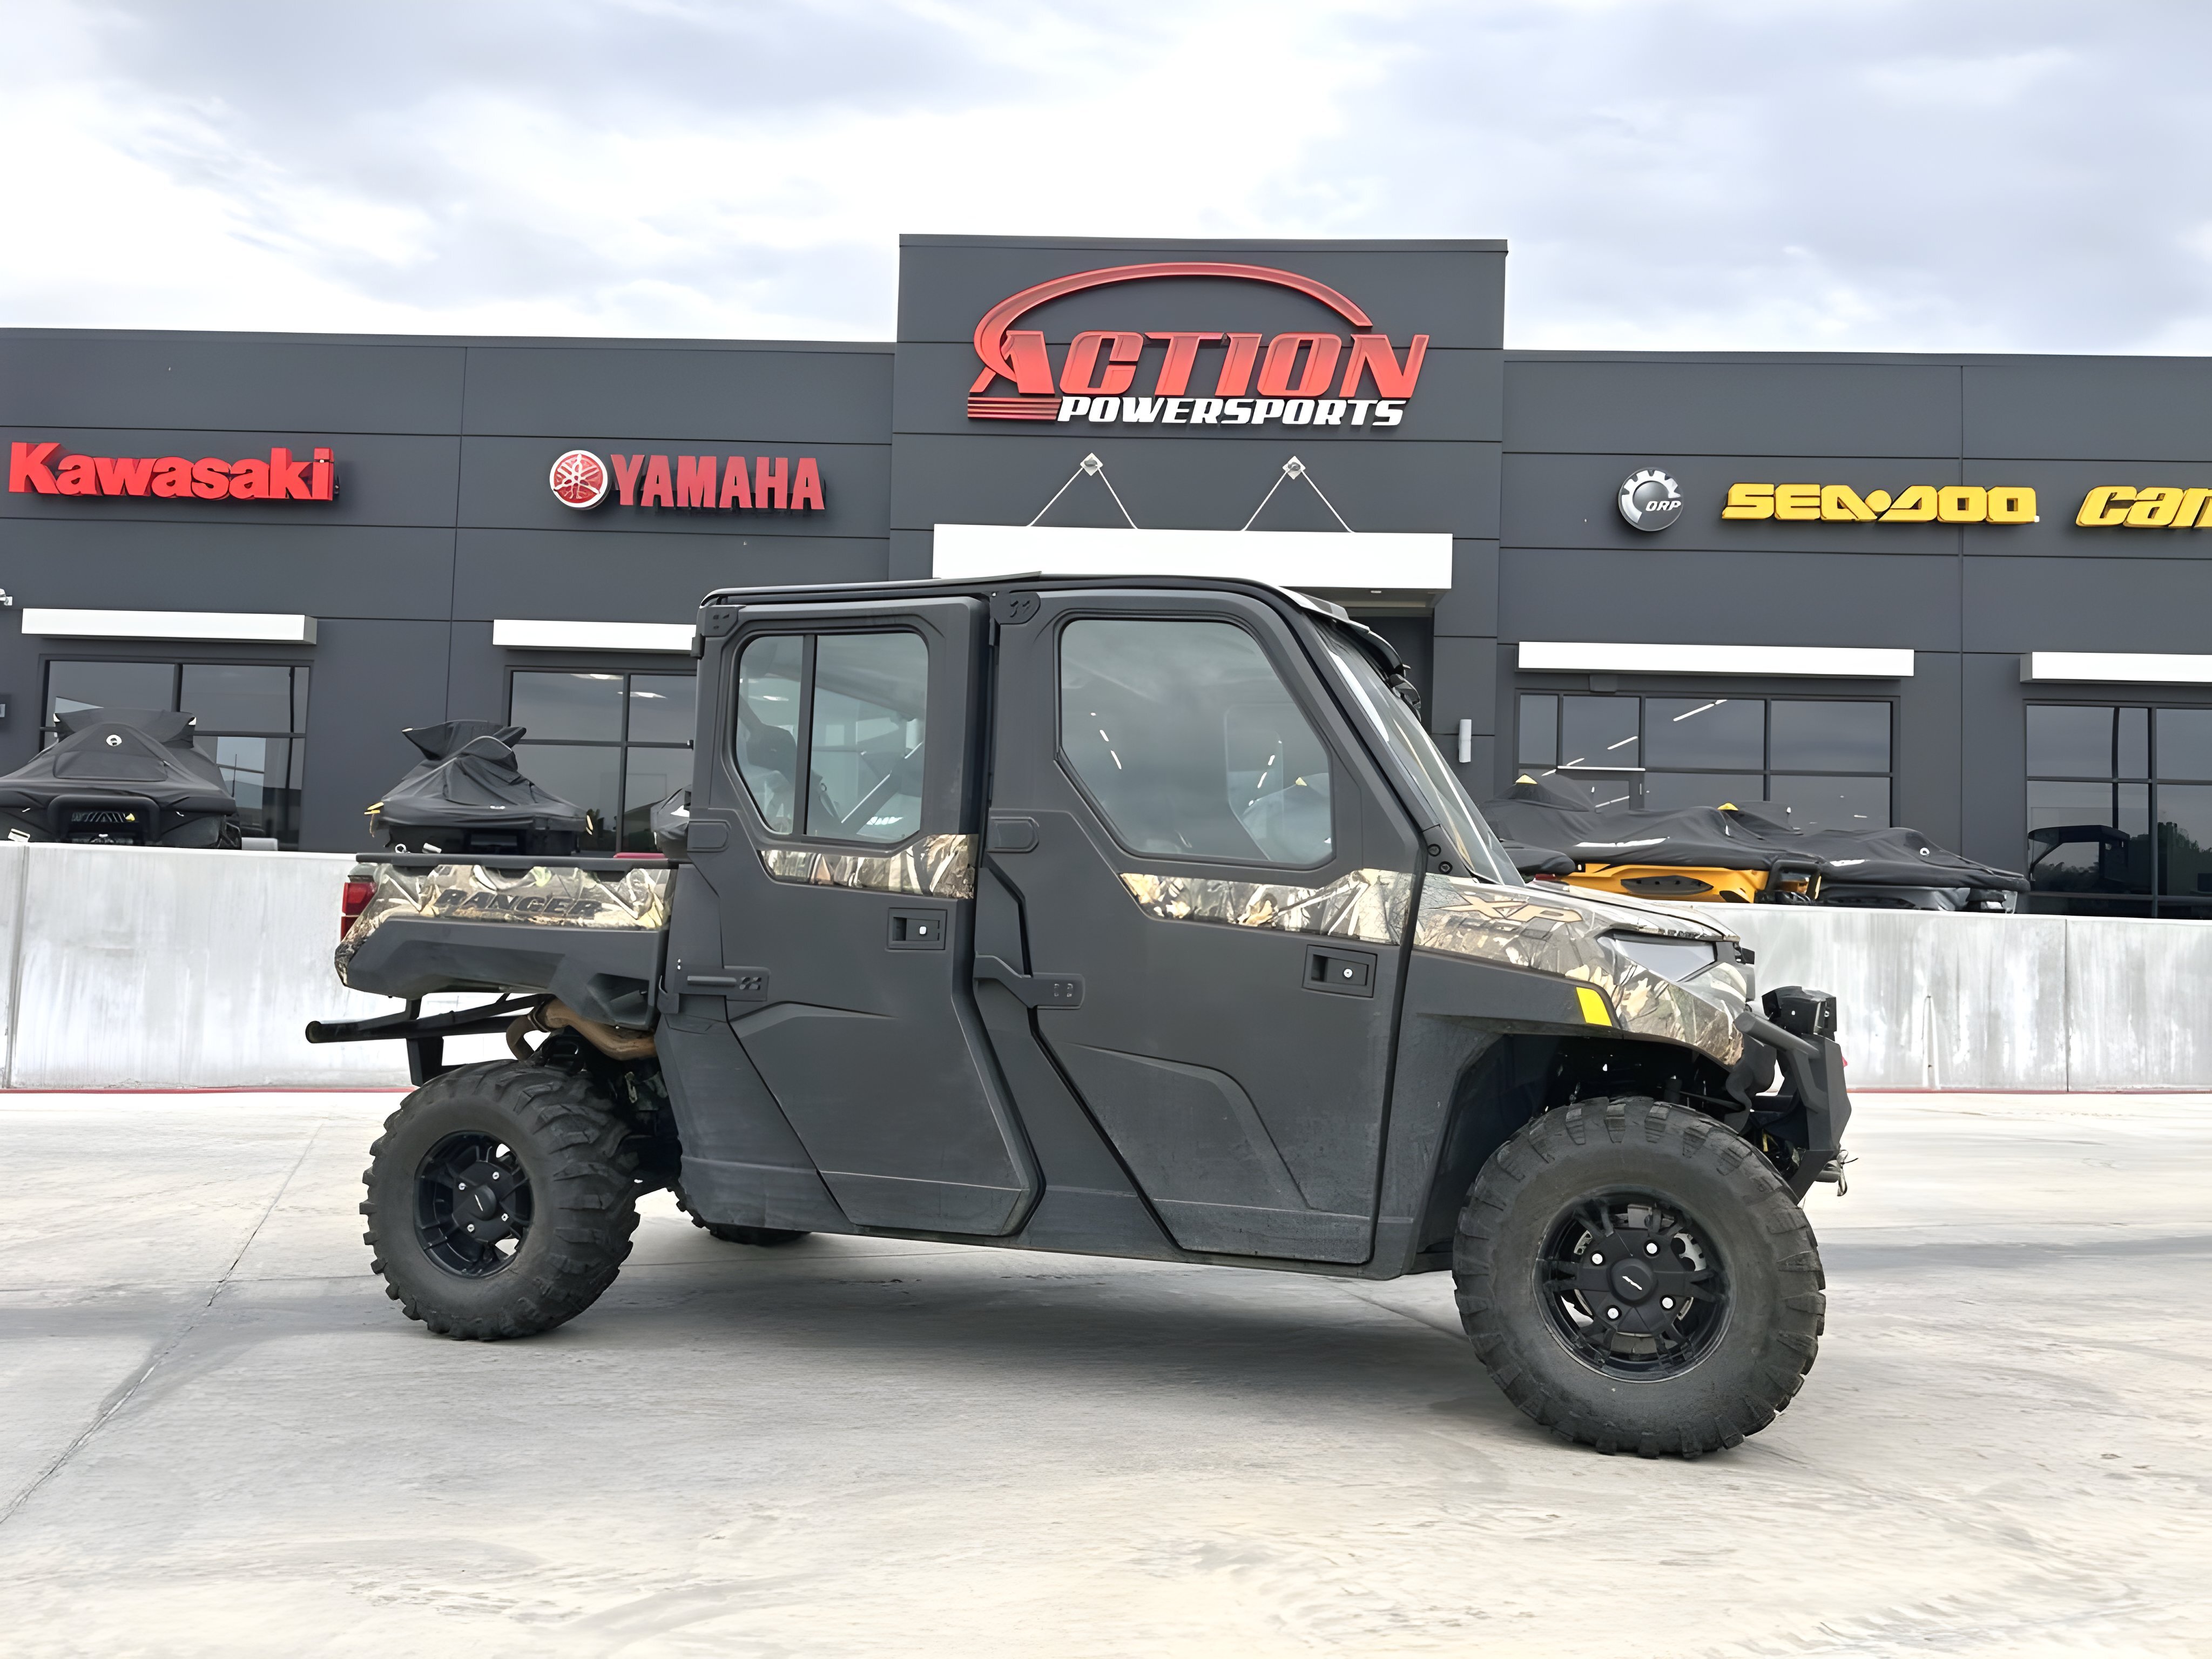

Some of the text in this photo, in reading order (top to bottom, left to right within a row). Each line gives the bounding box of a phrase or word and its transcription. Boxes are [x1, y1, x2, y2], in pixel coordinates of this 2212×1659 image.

[969, 329, 1430, 398] ACTION
[1057, 396, 1407, 427] POWERSPORTS
[9, 441, 335, 502] Kawasaki
[610, 454, 825, 510] YAMAHA
[434, 889, 603, 920] RANGER
[1431, 894, 1583, 922] XP
